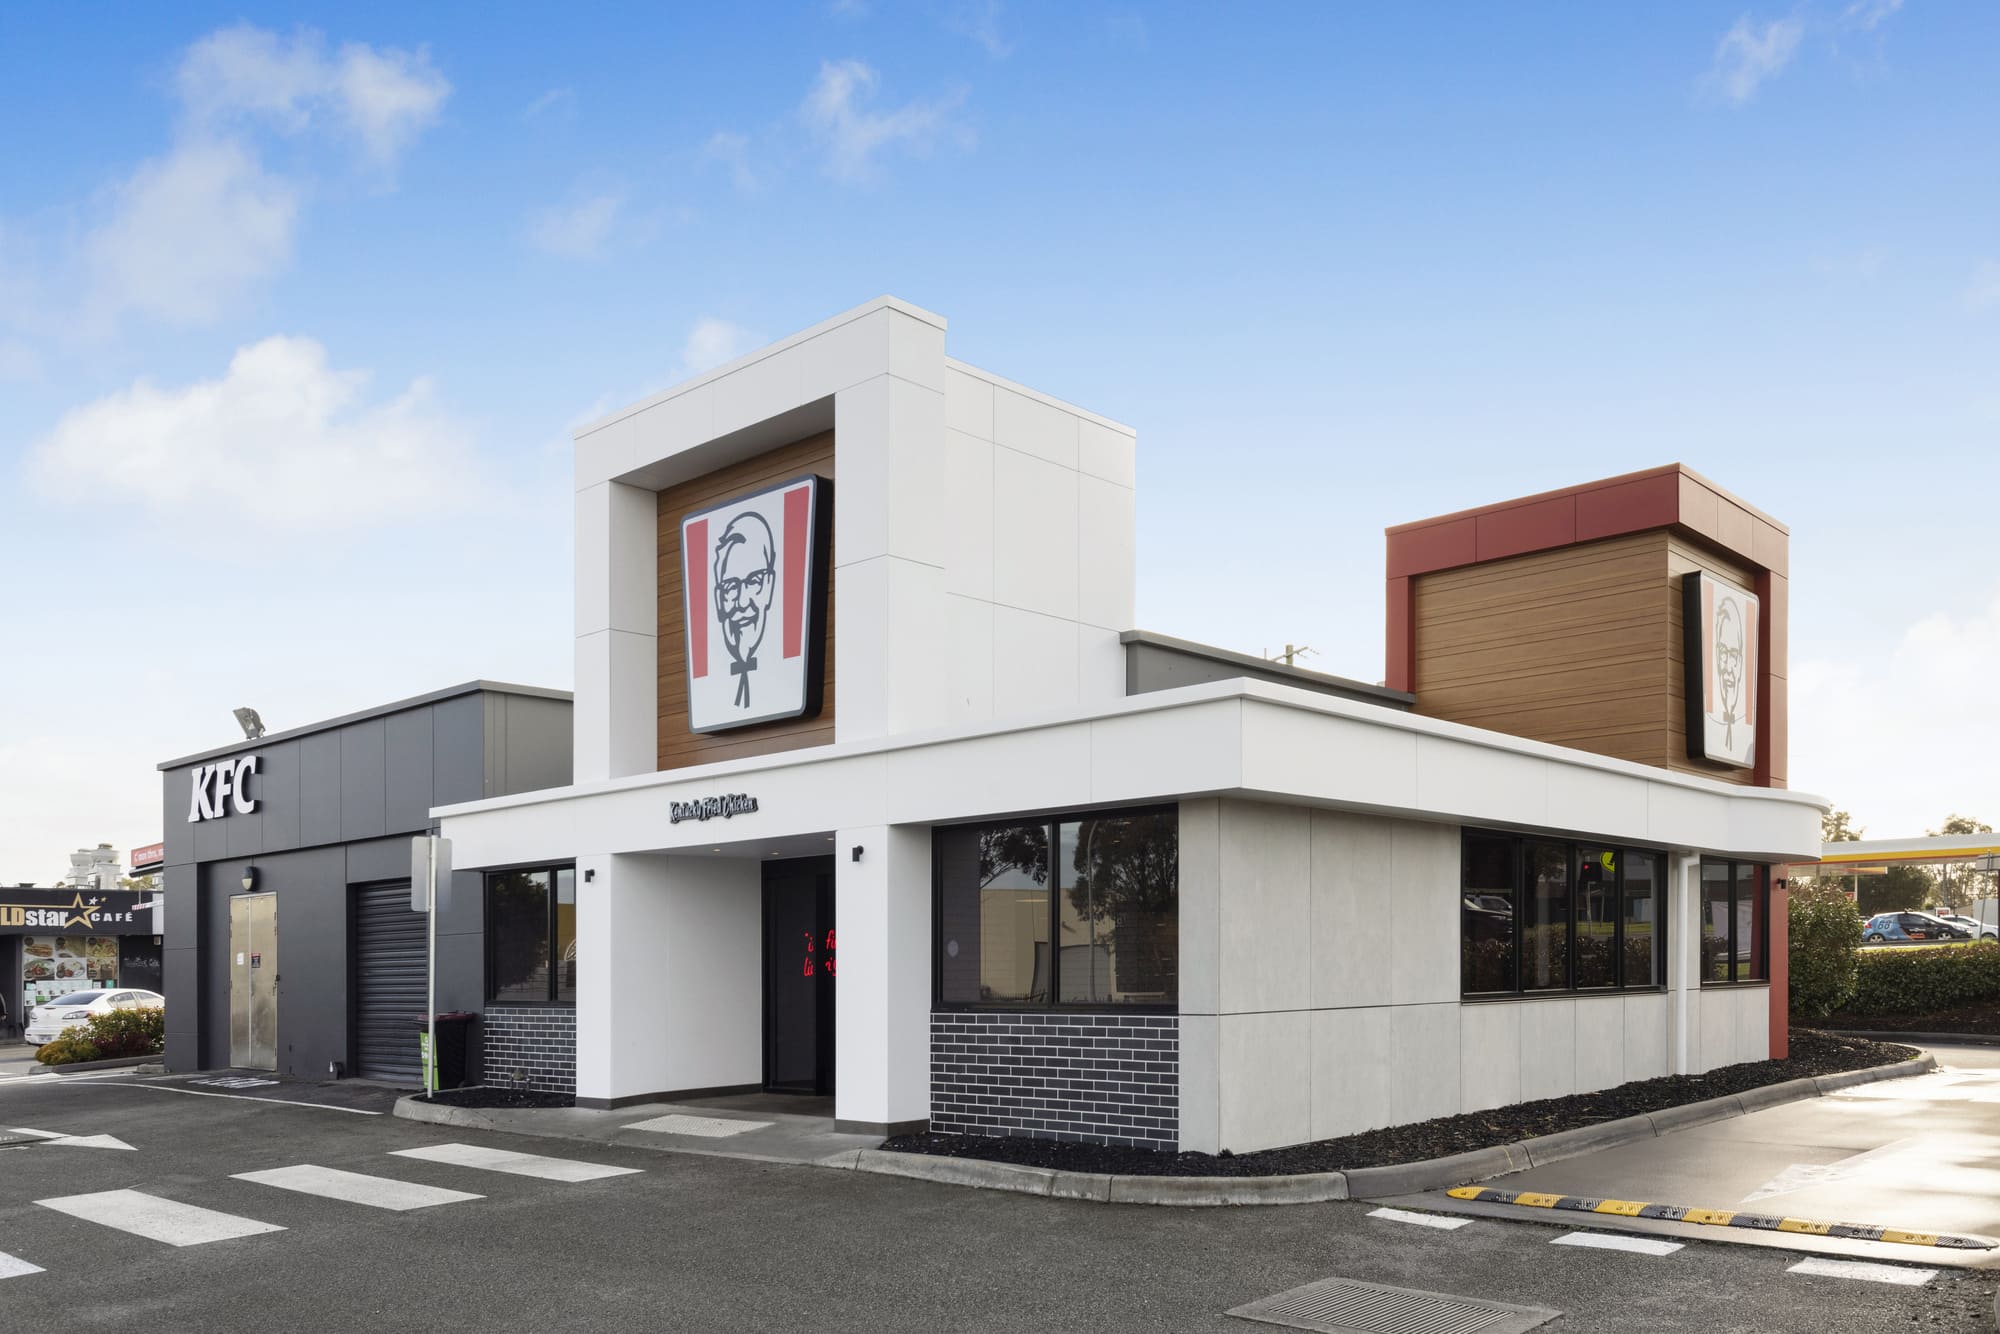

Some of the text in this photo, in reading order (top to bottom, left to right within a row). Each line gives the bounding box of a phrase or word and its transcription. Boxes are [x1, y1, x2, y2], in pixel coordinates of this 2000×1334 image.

[188, 755, 257, 823] KFC
[670, 793, 759, 824] Kentucky Fried Chicken
[91, 912, 133, 922] CAFÉ
